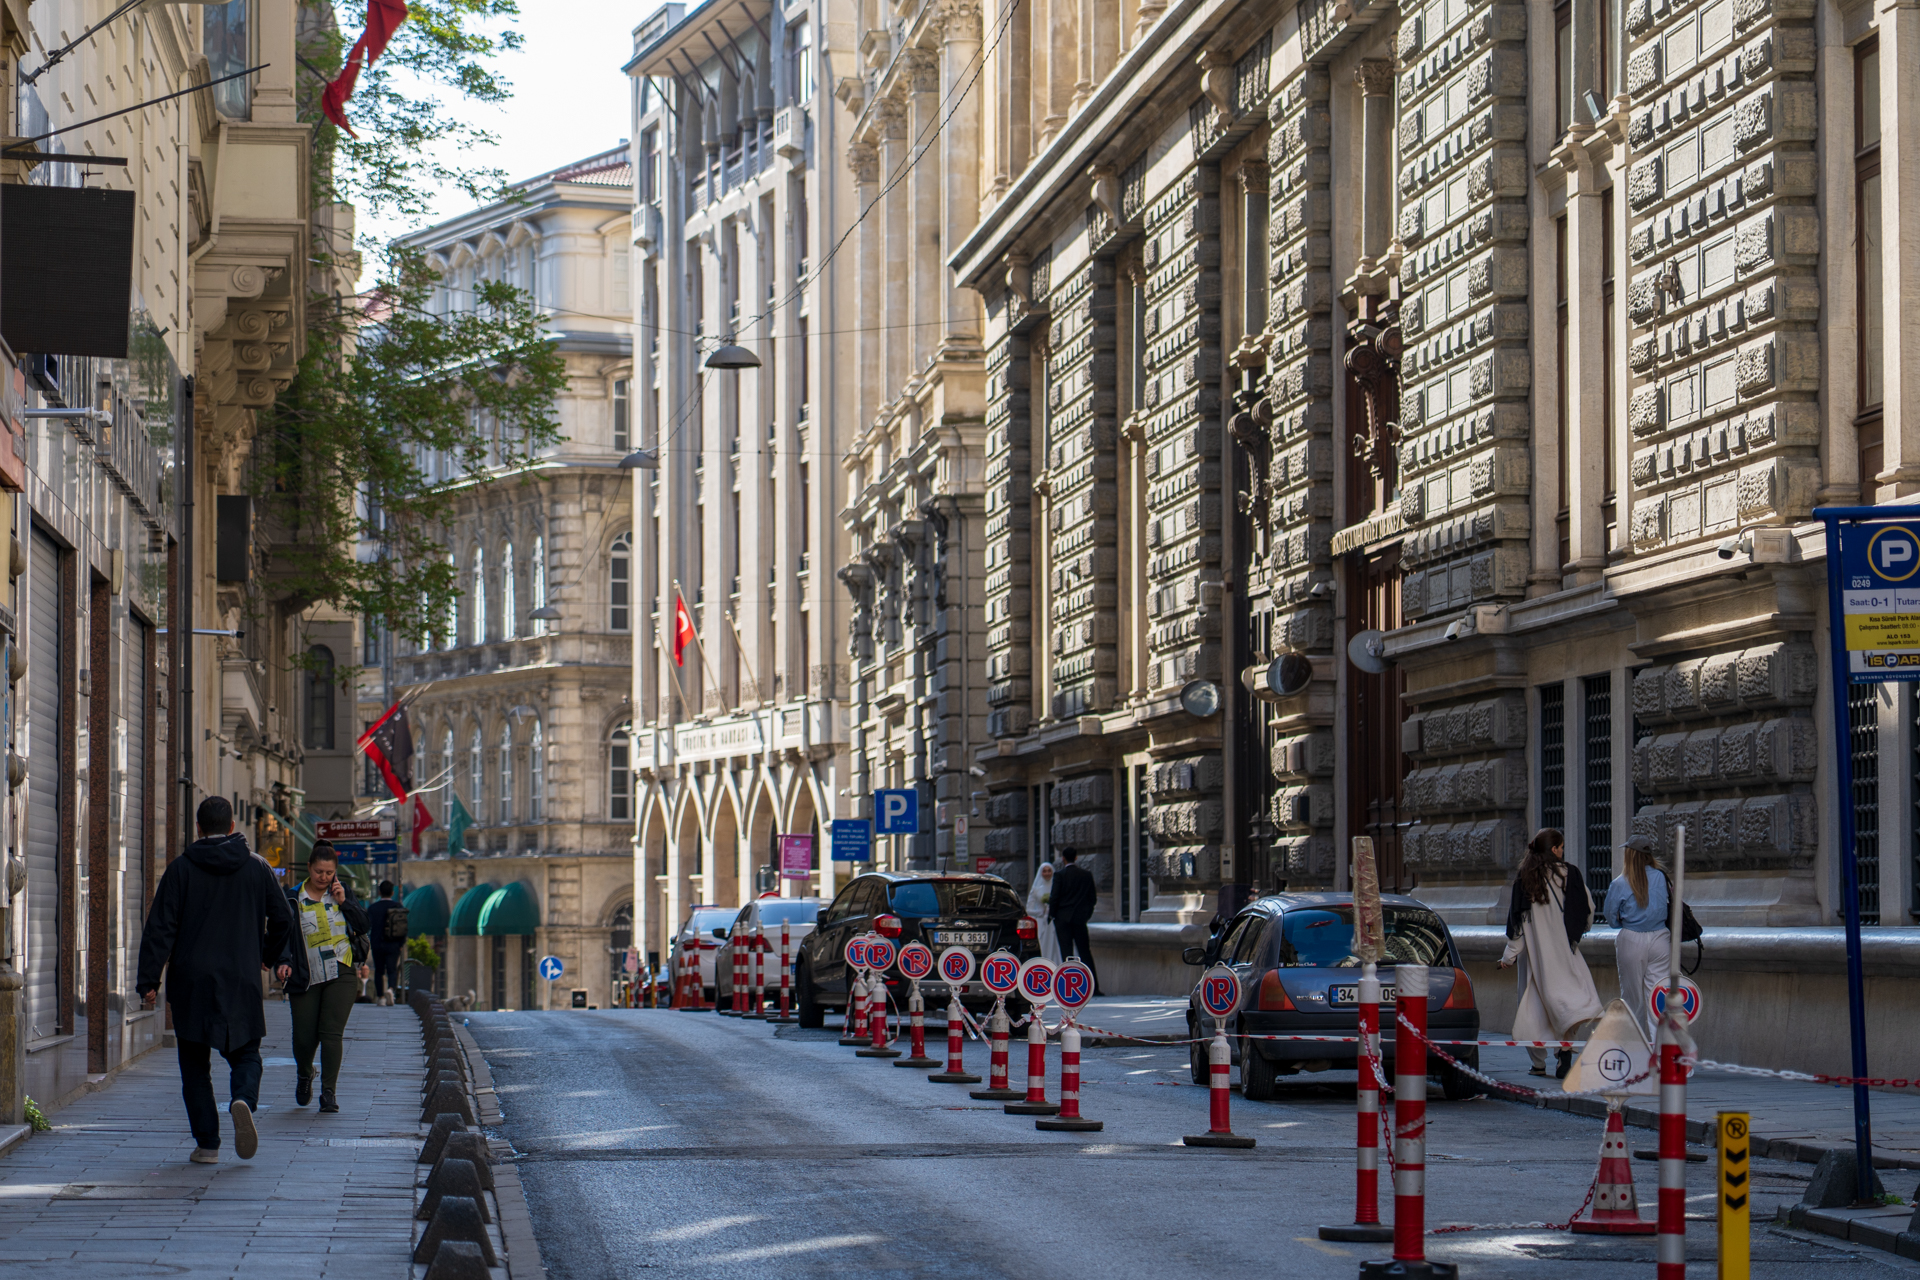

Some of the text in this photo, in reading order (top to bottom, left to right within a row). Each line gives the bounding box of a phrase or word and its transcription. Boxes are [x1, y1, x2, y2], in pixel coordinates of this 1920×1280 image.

[1881, 540, 1912, 568] P
[1852, 580, 1870, 588] 0249
[884, 794, 907, 829] P
[939, 933, 987, 942] 06 FK 3633
[1339, 988, 1354, 1001] 34
